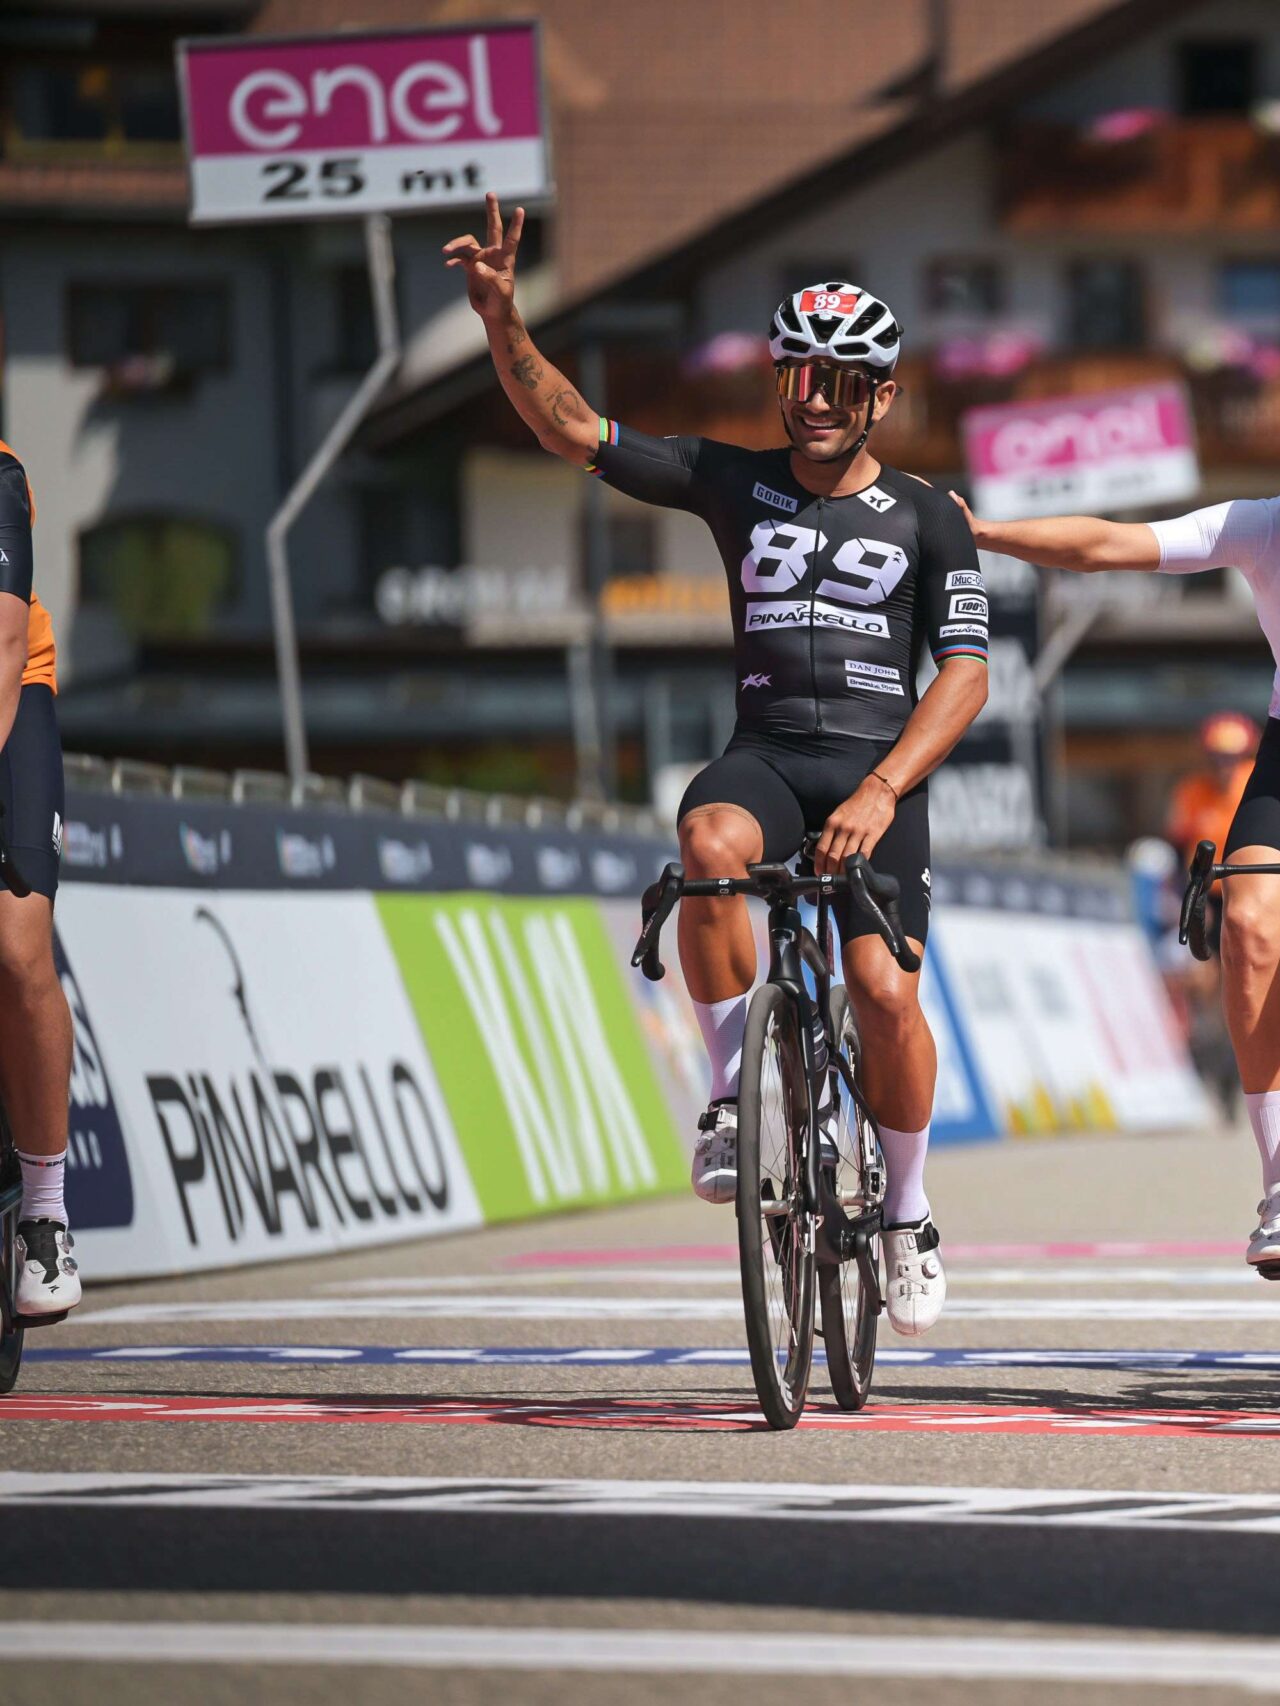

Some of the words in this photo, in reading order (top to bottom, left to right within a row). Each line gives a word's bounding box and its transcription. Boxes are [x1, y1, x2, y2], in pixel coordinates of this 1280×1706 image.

[229, 34, 502, 150] enel
[261, 157, 365, 203] 25
[401, 162, 482, 193] mt
[813, 294, 841, 310] 89
[756, 485, 794, 511] GOBIK
[740, 518, 910, 607] 89
[954, 575, 984, 586] Muc-O
[961, 602, 985, 613] 100%
[748, 610, 883, 634] PINARELLO
[942, 627, 988, 638] PINARELL
[849, 662, 871, 672] DAN
[874, 667, 897, 676] JOHN
[146, 1058, 449, 1246] PINARELLO
